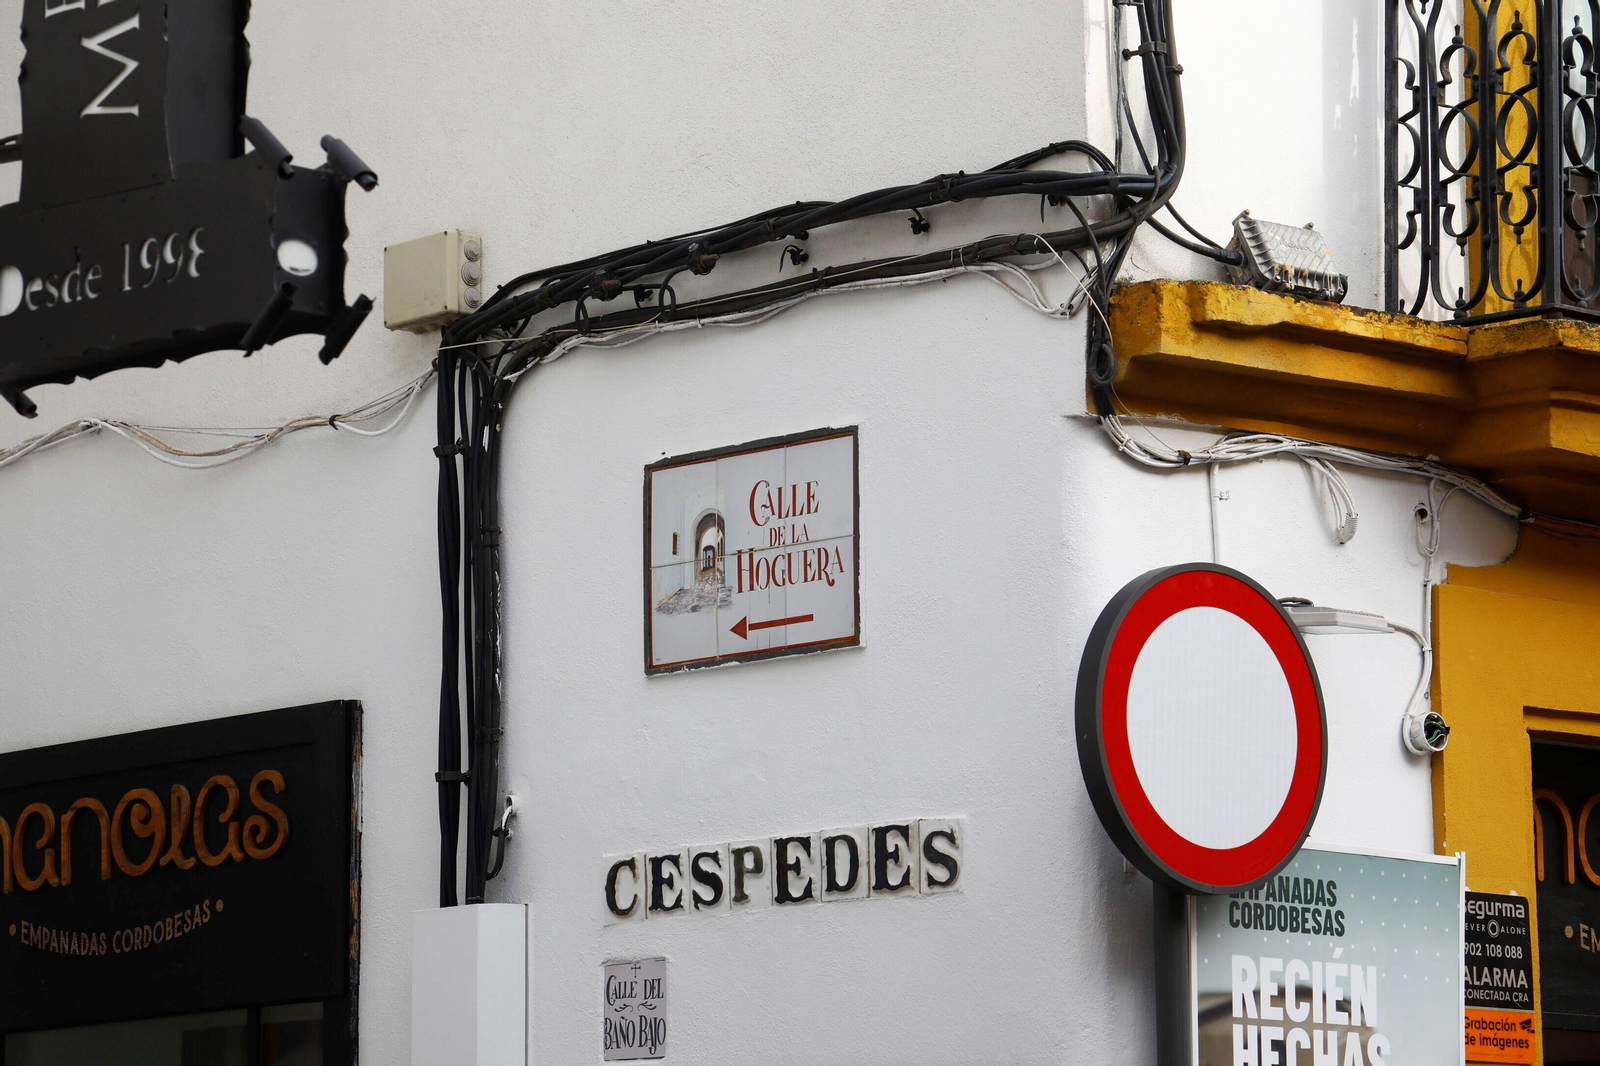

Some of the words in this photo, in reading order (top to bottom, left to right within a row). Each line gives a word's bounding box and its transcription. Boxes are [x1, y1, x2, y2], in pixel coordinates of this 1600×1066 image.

[749, 480, 820, 527] CALLE
[769, 526, 786, 548] DE
[791, 522, 810, 544] LA
[735, 544, 845, 594] HOGUERA
[604, 824, 959, 918] CESPEDES
[1229, 875, 1338, 908] ANADAS
[1229, 900, 1346, 938] CORDOBESAS
[1464, 900, 1526, 920] egurma
[20, 920, 107, 956] EMPANADAS
[112, 899, 211, 954] CORDOBESAS
[1500, 924, 1526, 935] ALONE
[1486, 943, 1502, 958] 108
[1505, 945, 1523, 959] 088
[606, 975, 638, 1006] CALLE
[643, 978, 664, 1000] DEL
[1231, 947, 1378, 1028] RECIÉN
[1464, 988, 1511, 1002] ONECTADA
[1512, 991, 1530, 1003] CRA
[604, 1016, 636, 1051] BAÑO
[637, 1015, 667, 1055] BAJO
[1479, 1033, 1530, 1051] imágenes
